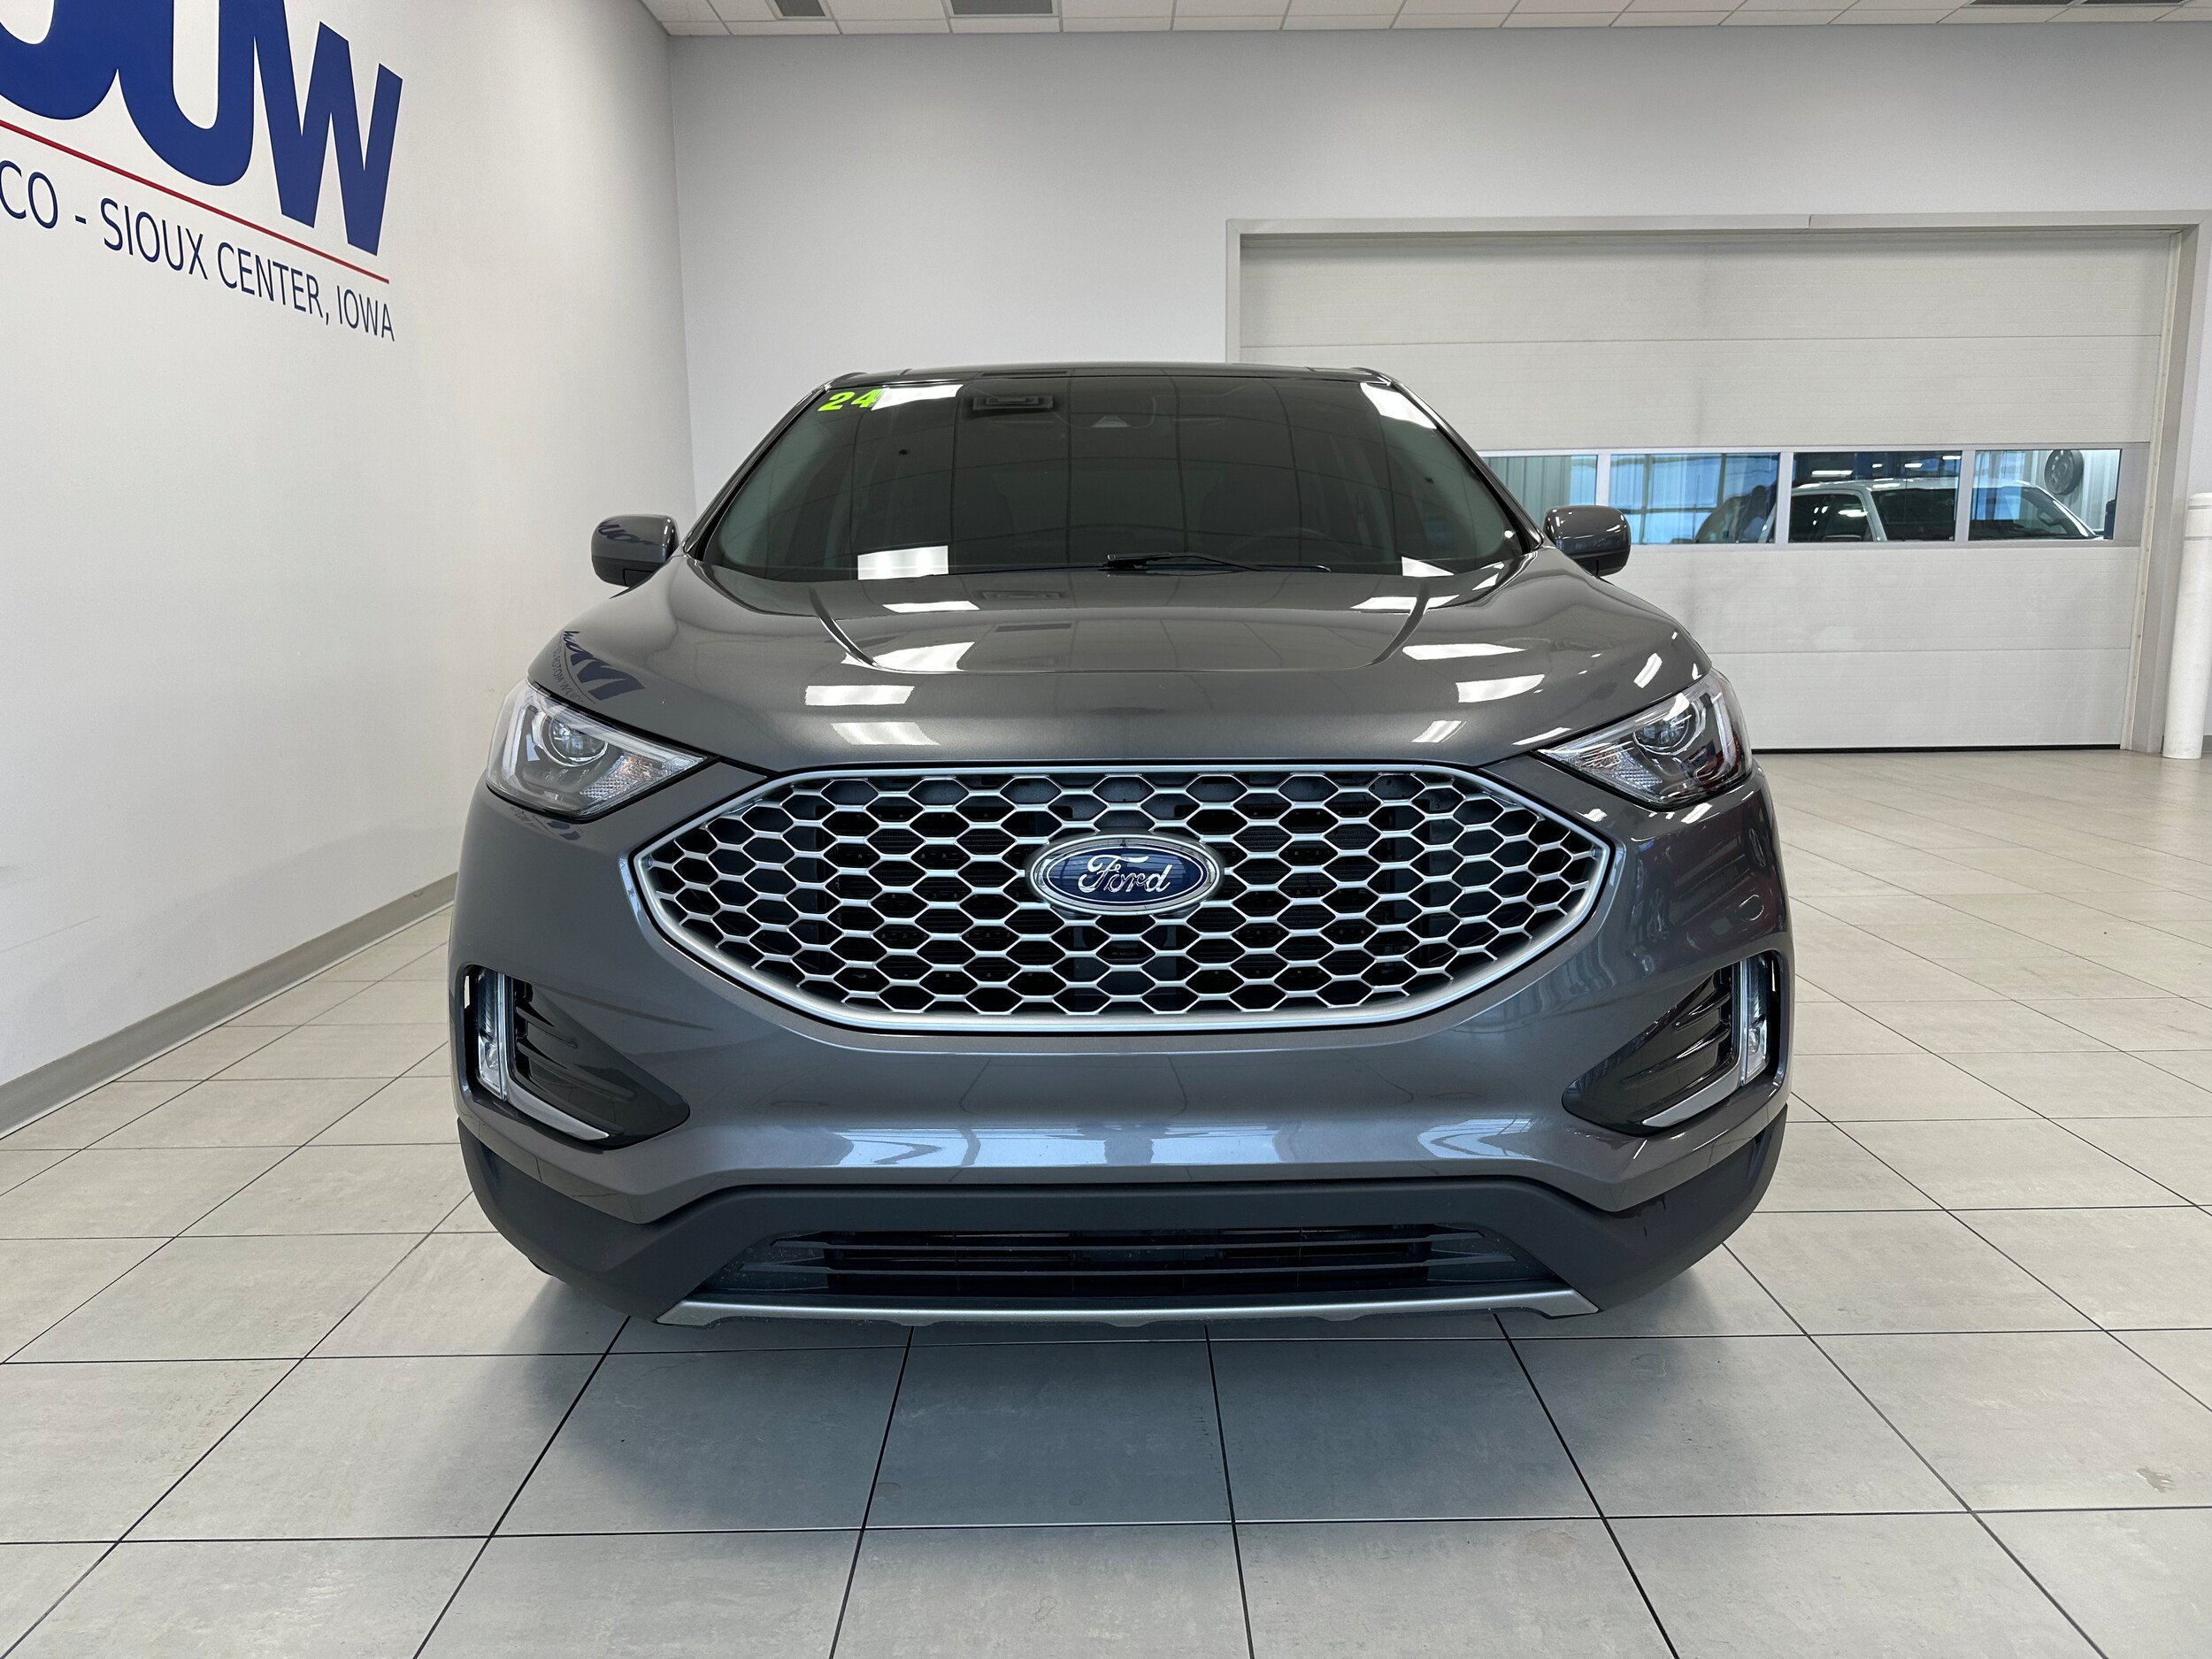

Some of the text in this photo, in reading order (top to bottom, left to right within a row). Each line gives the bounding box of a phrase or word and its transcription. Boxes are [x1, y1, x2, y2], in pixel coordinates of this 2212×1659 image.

[0, 160, 395, 342] CO - SIOUX CENTER, IOWA
[817, 388, 883, 412] 24
[1078, 854, 1173, 893] Ford
